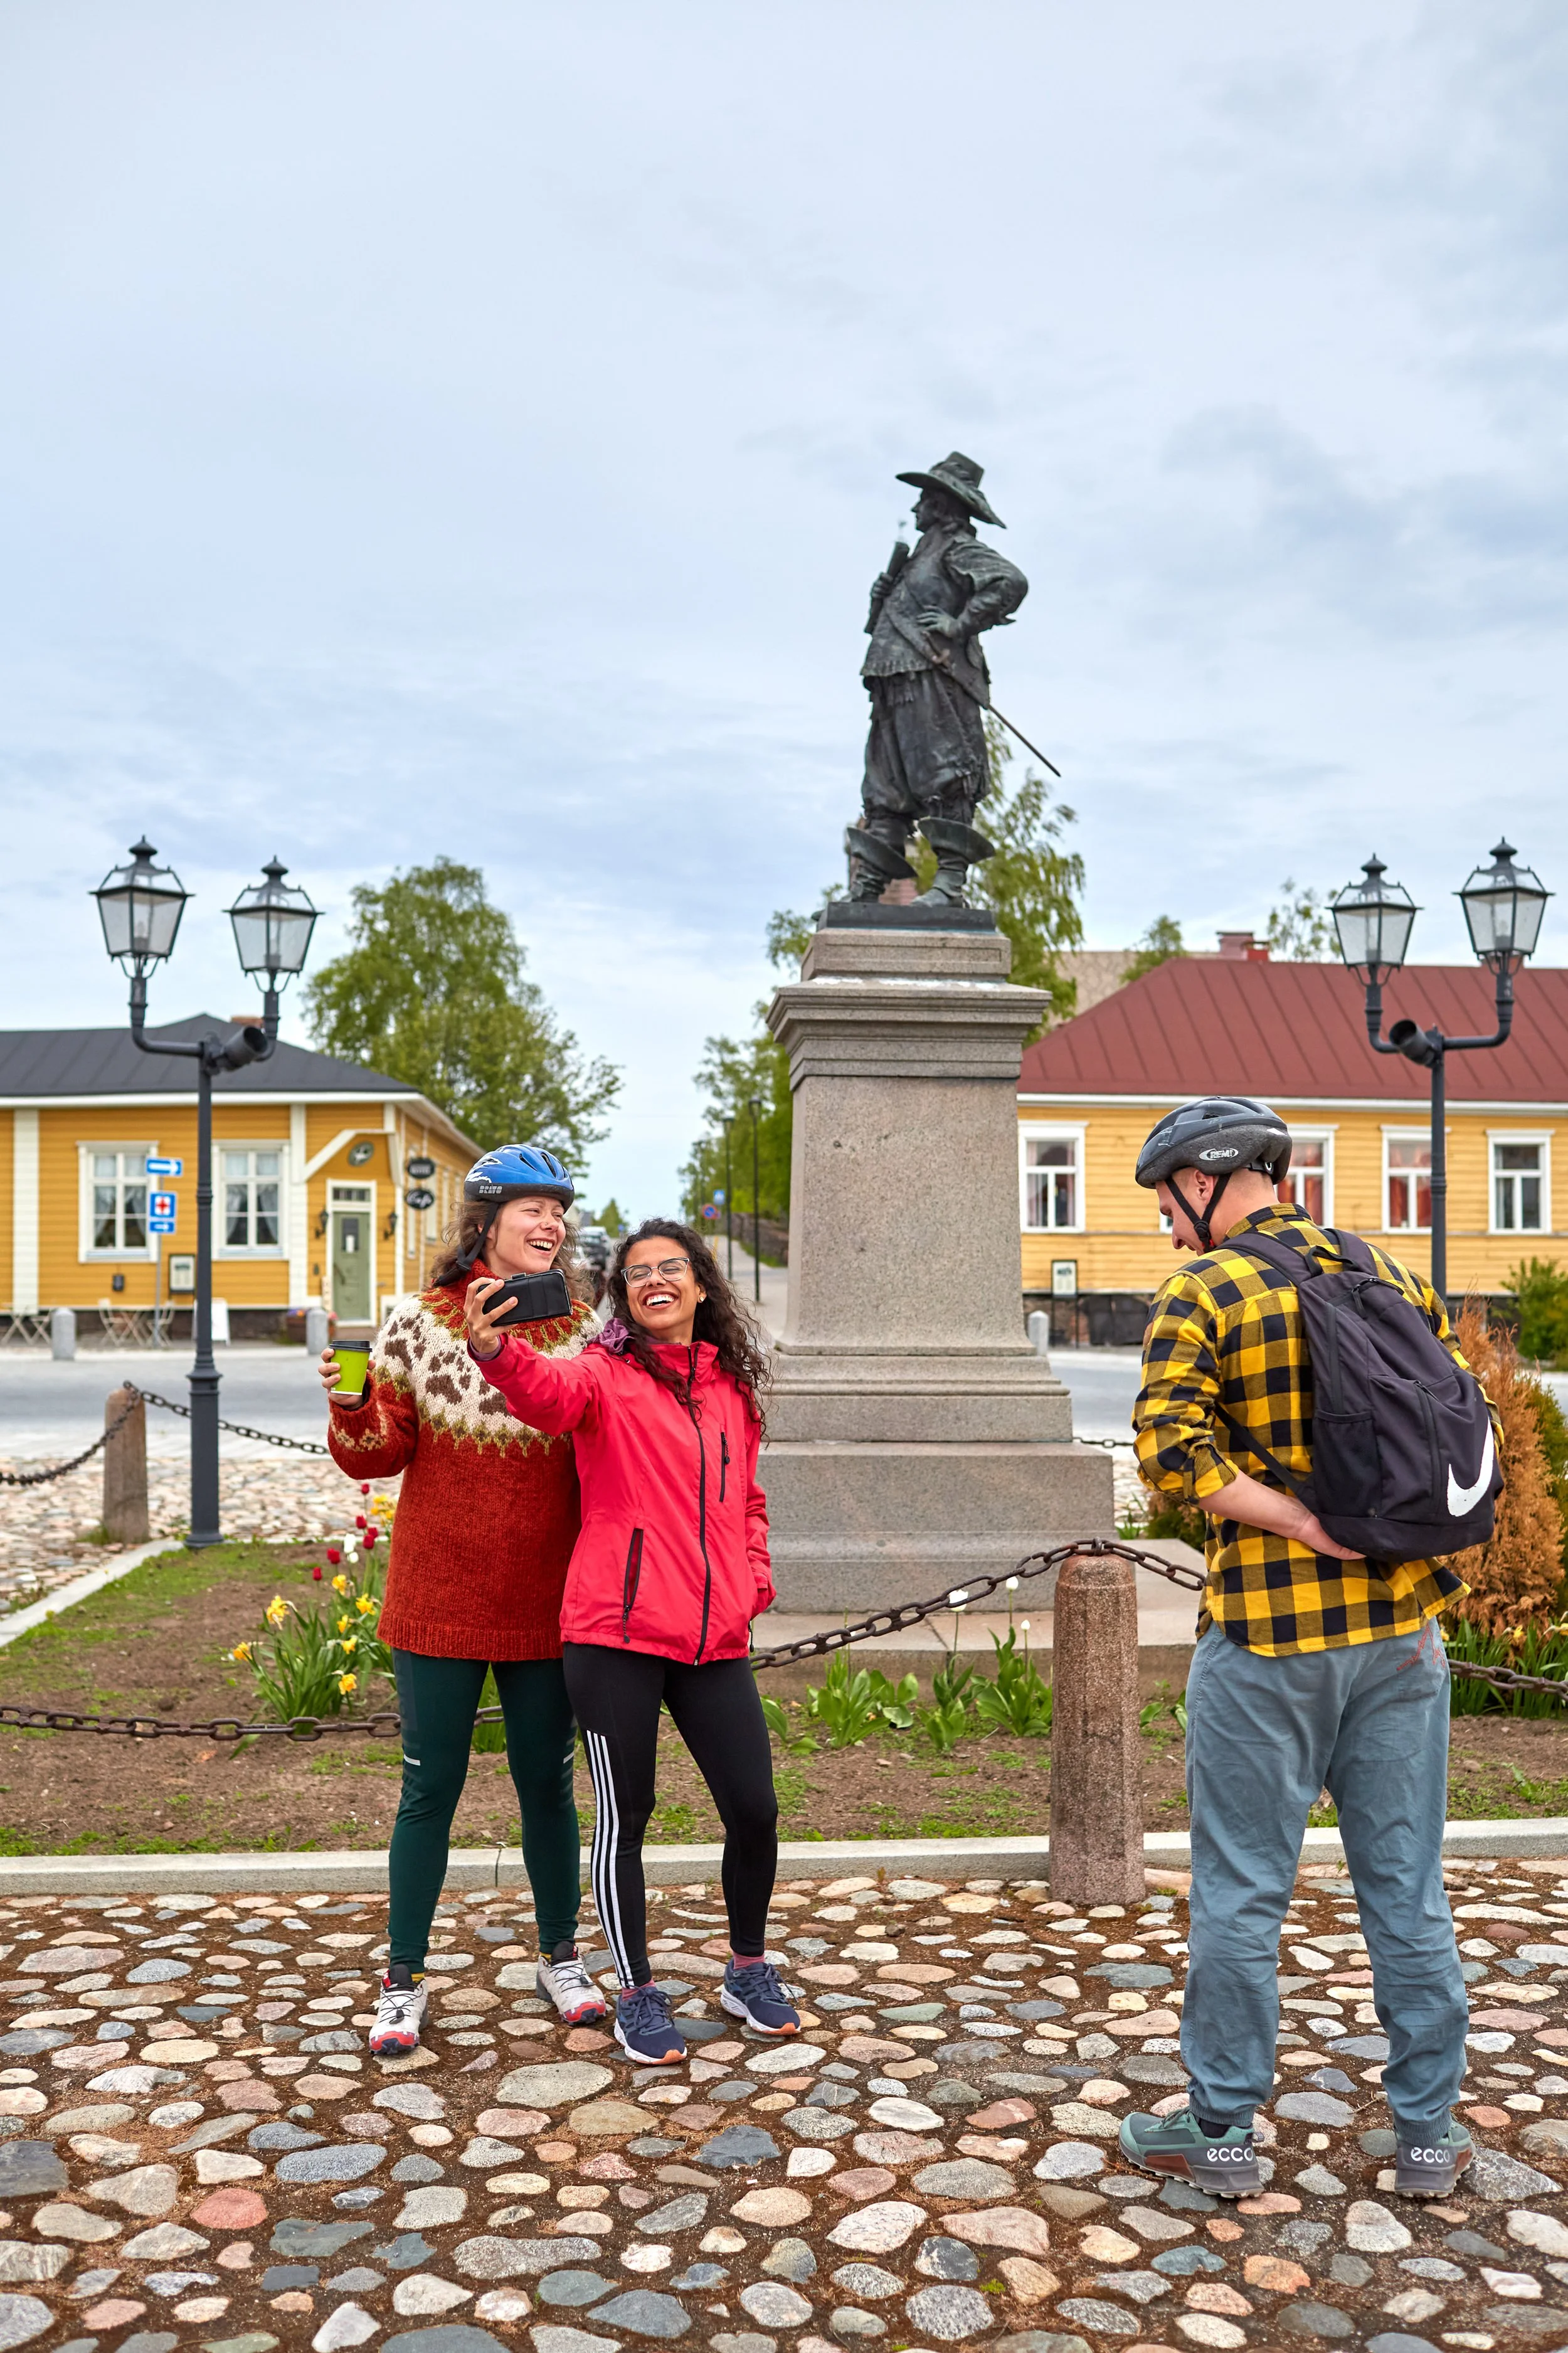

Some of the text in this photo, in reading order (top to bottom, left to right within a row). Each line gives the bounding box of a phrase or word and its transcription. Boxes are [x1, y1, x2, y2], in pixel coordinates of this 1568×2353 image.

[479, 1186, 502, 1194] BRAVO
[1207, 2147, 1254, 2162] ecco
[1410, 2147, 1450, 2164] ecco
